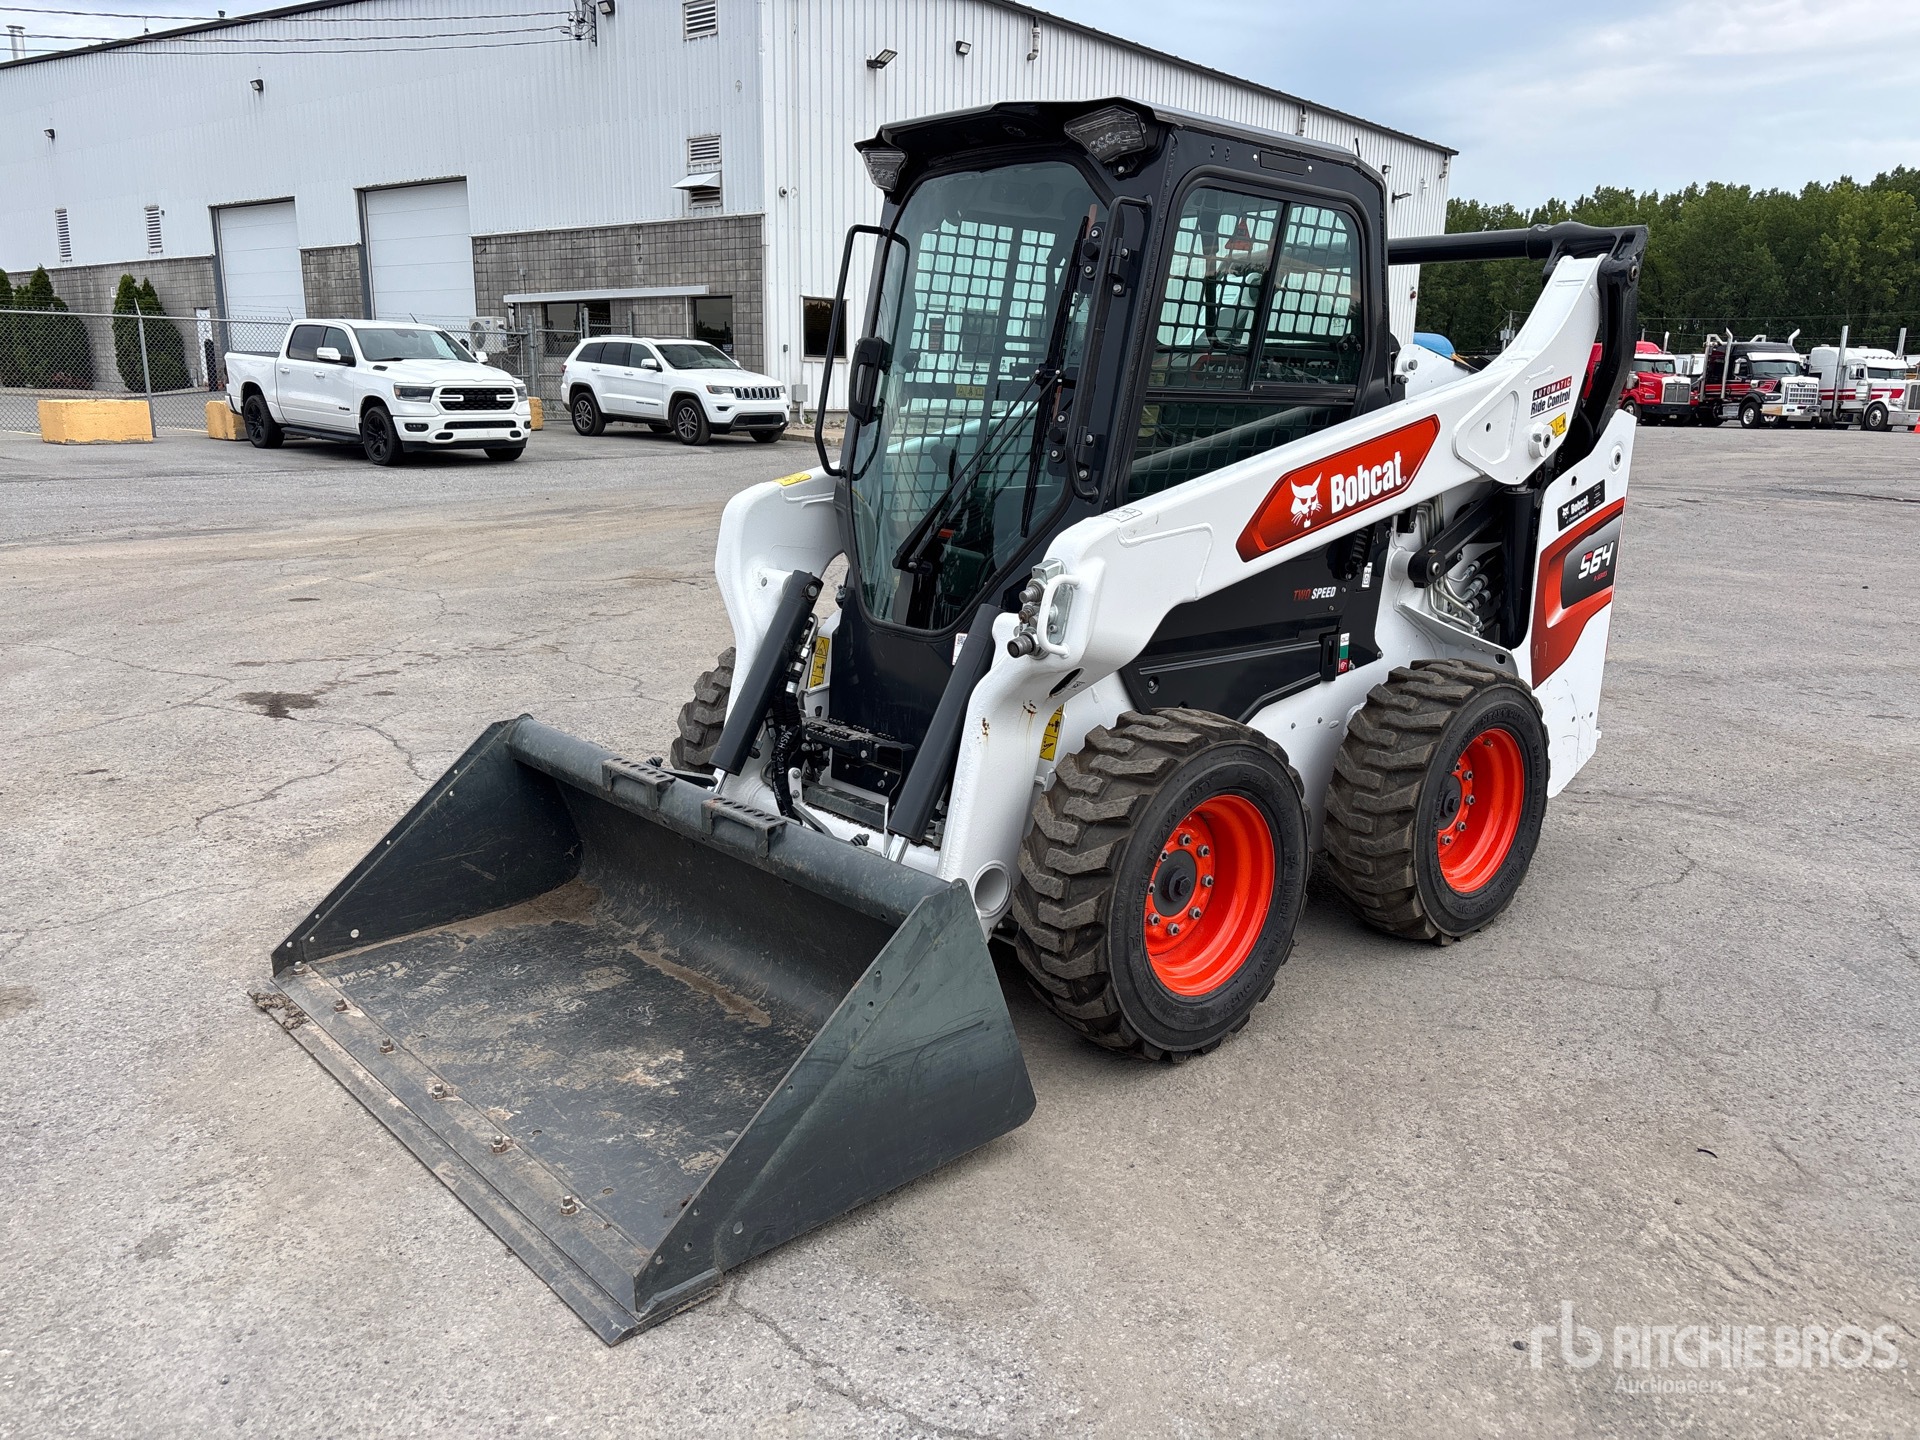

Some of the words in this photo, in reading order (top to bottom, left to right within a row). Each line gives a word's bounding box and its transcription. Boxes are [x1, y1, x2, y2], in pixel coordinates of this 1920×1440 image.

[1531, 399, 1546, 415] Ride
[1547, 388, 1571, 408] Control
[1533, 378, 1571, 399] AUTOMATIC
[1331, 451, 1402, 514] Bobcat
[1578, 541, 1614, 579] S64
[1293, 589, 1311, 600] TWO
[1311, 586, 1337, 600] SPEED
